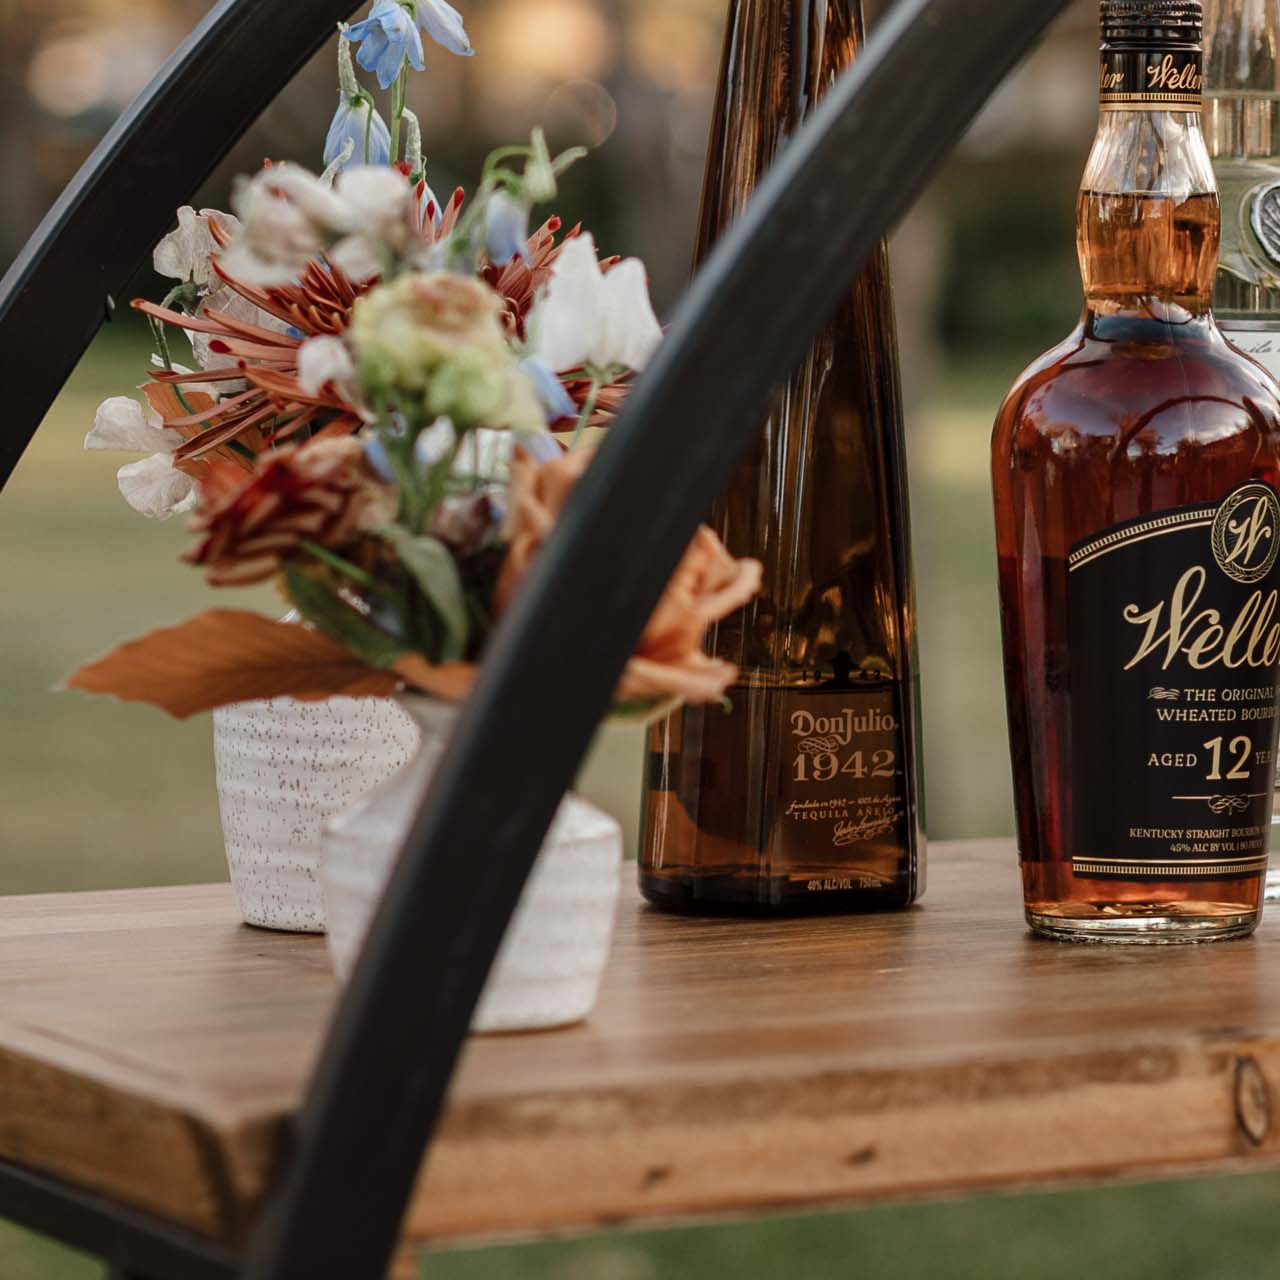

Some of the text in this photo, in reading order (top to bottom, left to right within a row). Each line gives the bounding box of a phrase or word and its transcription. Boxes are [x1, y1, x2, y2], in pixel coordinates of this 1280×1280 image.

[1225, 496, 1271, 565] W
[1184, 688, 1217, 701] THE
[1221, 687, 1274, 701] ORIGINAL
[1156, 708, 1237, 721] WHEATED
[1148, 753, 1197, 767] AGED
[1203, 736, 1251, 780] 12
[793, 749, 895, 781] 1942
[792, 809, 849, 820] TEQUILA
[1129, 828, 1183, 839] KENTUCKY
[1186, 828, 1229, 839] STRAIGHT
[1170, 843, 1191, 852] 45%
[1192, 842, 1209, 852] ALC
[1210, 842, 1220, 852] BY
